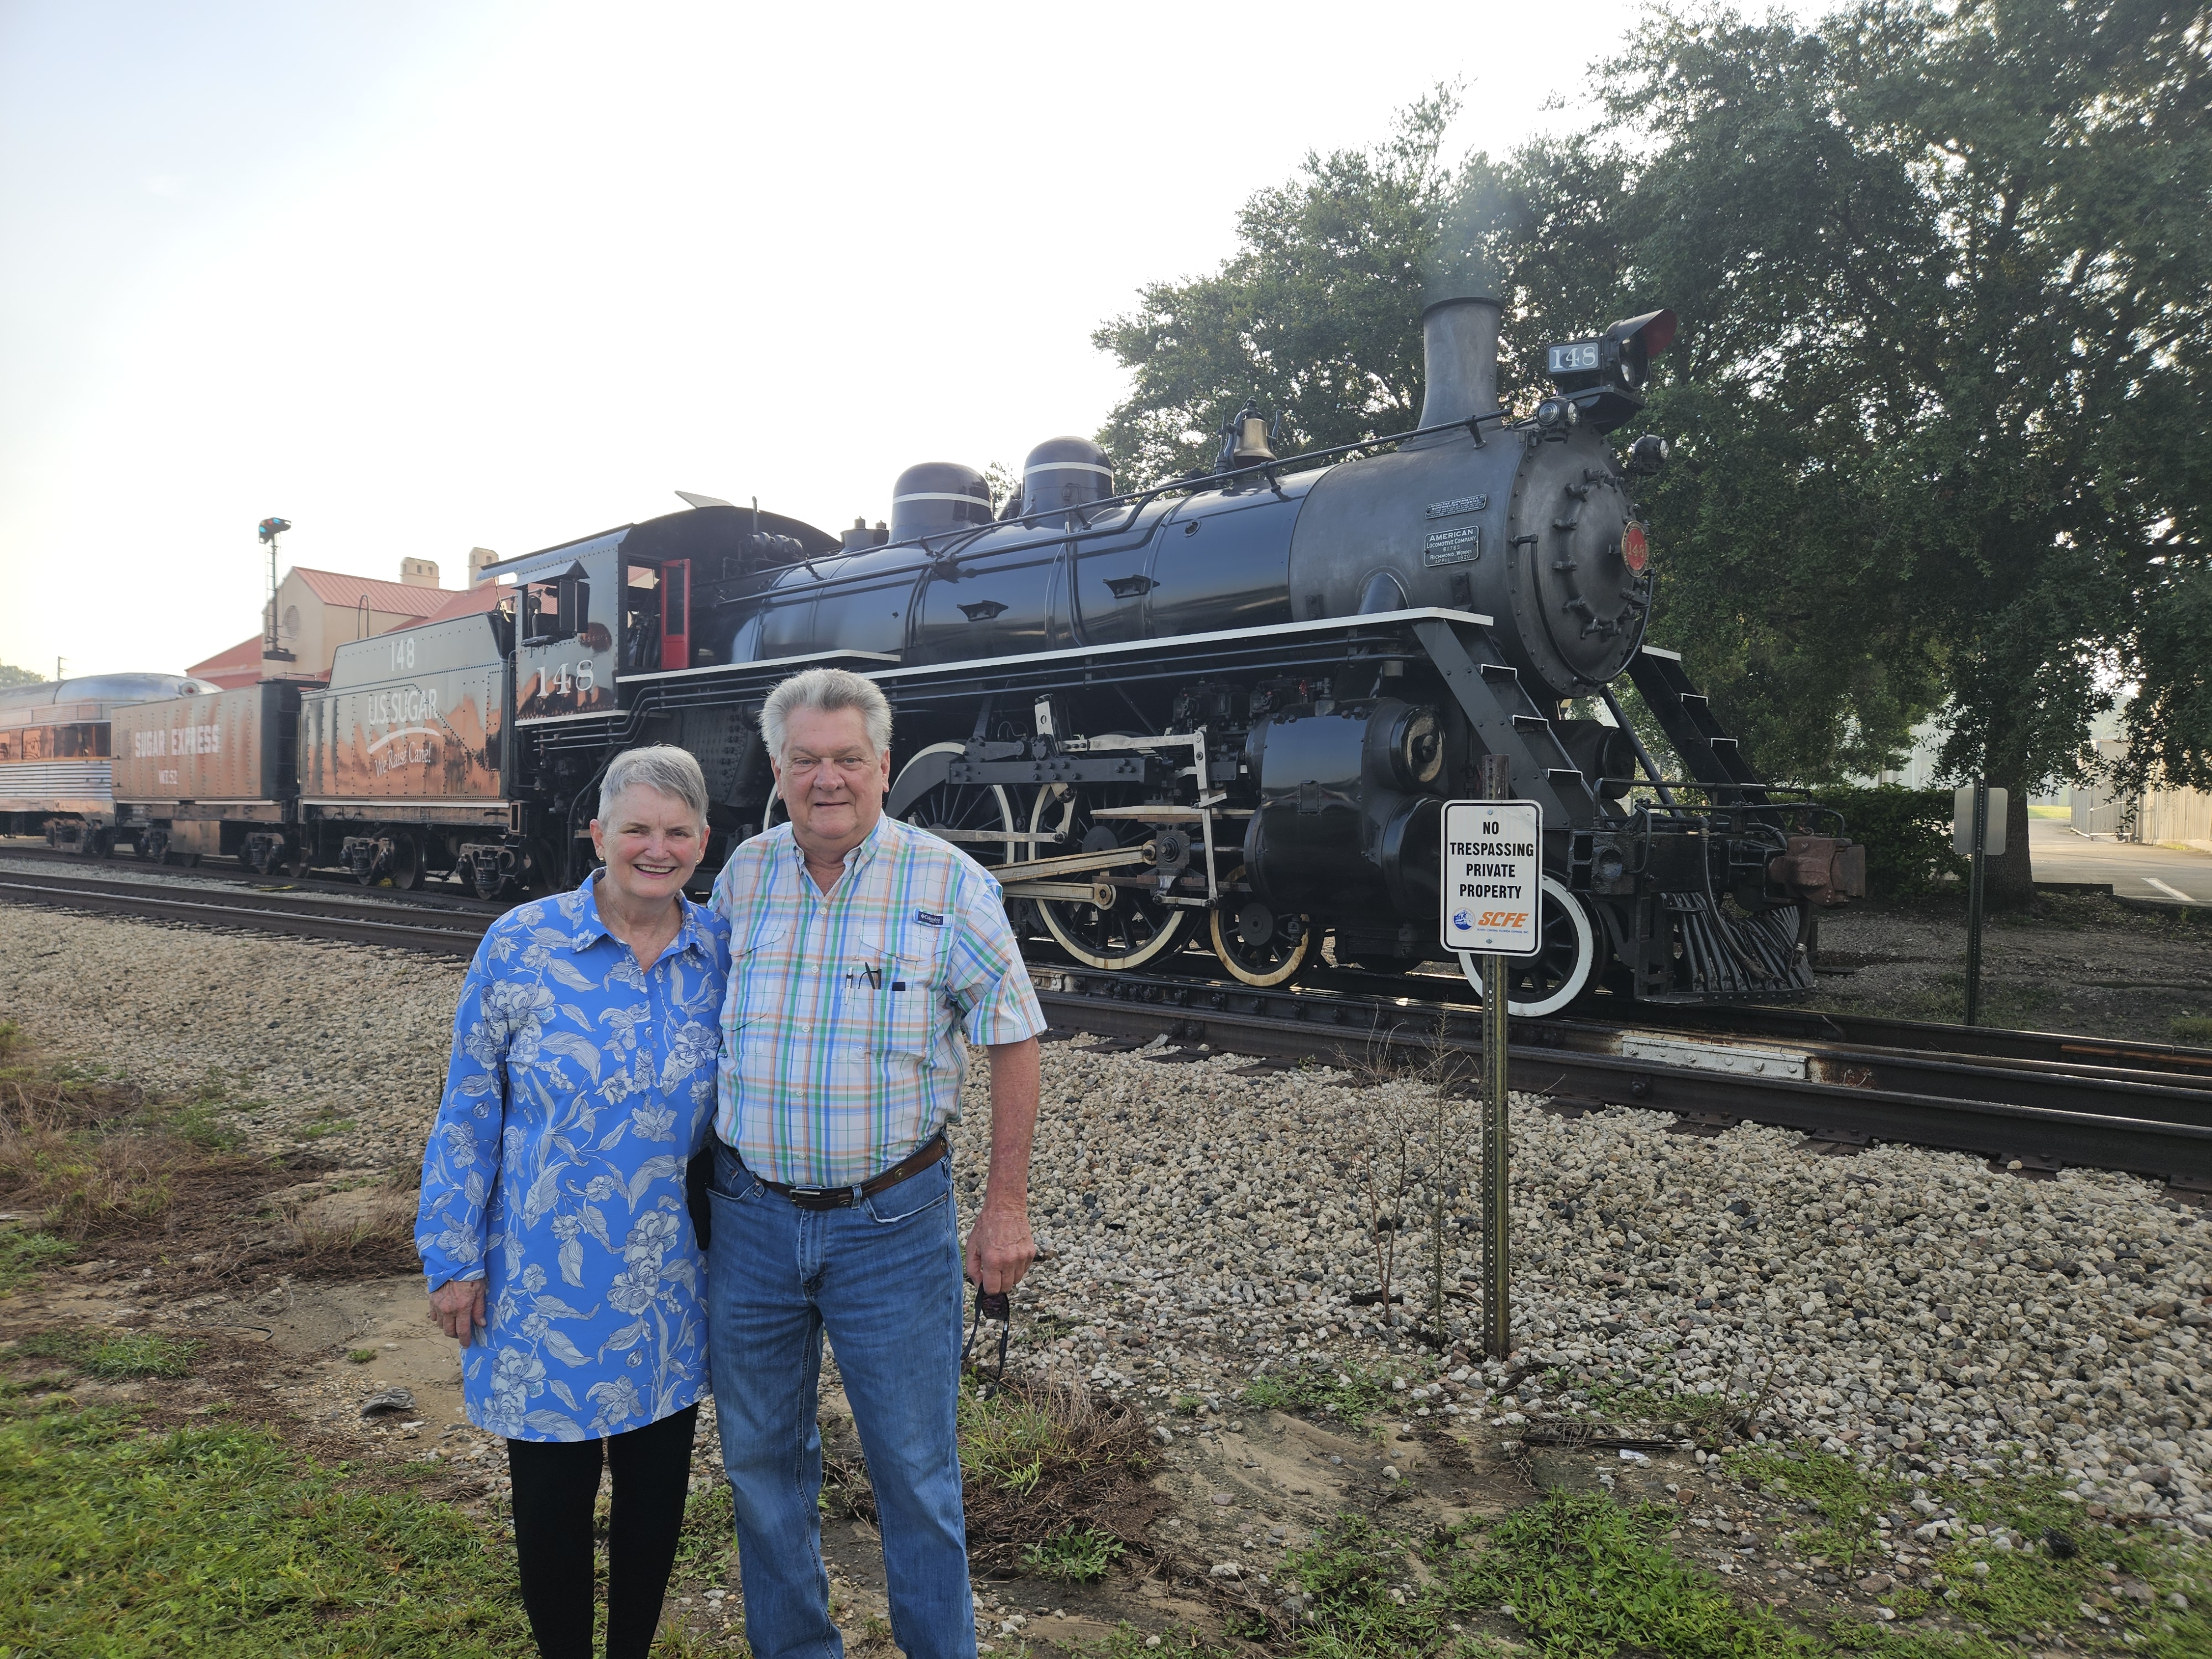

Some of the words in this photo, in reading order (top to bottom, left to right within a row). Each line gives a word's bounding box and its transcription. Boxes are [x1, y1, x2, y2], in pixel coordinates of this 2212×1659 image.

[1553, 347, 1595, 368] 148
[1426, 540, 1454, 549] LOCOMOTIVE
[1454, 535, 1477, 544] COMPANY
[1429, 528, 1473, 541] AMERICAN
[1627, 541, 1645, 558] 148
[392, 638, 414, 671] 148
[536, 660, 594, 697] 148
[390, 688, 438, 723] SUGAR
[135, 729, 165, 758] SUGAR
[171, 724, 220, 756] EXPRESS
[374, 755, 387, 778] We
[387, 747, 407, 770] Raise
[409, 742, 431, 763] Cane!
[1483, 821, 1499, 834] NO
[1449, 842, 1534, 857] TRESPASSING
[1466, 863, 1515, 878] PRIVATE
[1459, 884, 1522, 899] PROPERTY
[1478, 911, 1529, 927] SCFE
